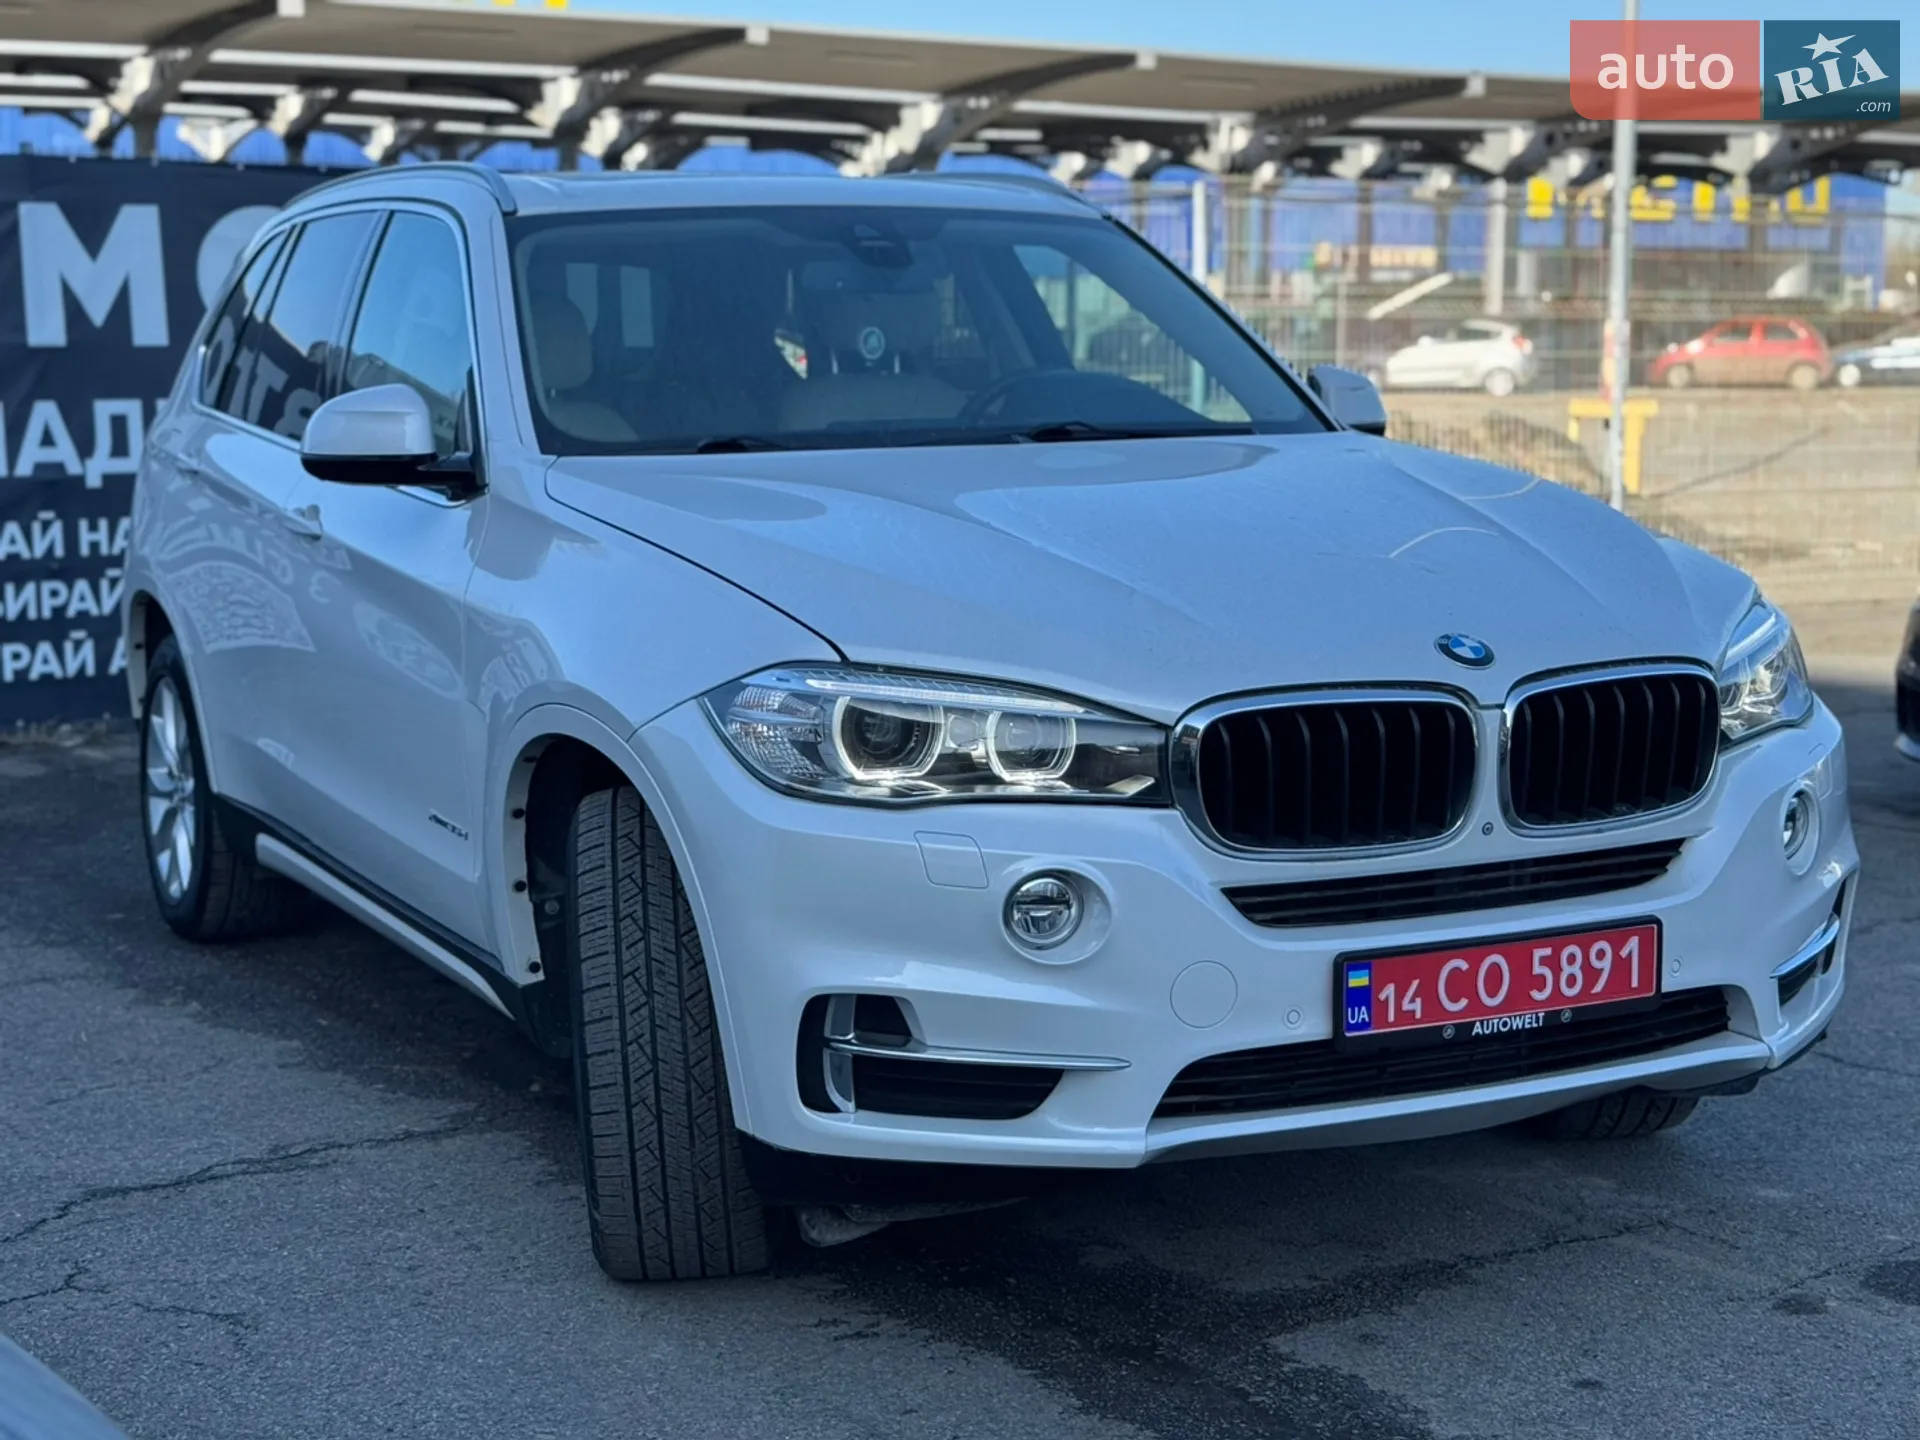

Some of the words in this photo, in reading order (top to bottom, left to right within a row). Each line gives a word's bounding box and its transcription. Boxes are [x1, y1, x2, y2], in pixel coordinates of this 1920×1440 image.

[0, 398, 174, 489] АД
[0, 568, 125, 622] ИРАЙ
[1378, 978, 1423, 1023] 14
[1437, 953, 1511, 1012] CO
[1529, 935, 1641, 1001] 5891
[1348, 1006, 1370, 1025] UA
[1471, 1012, 1545, 1037] AUTOWELT
